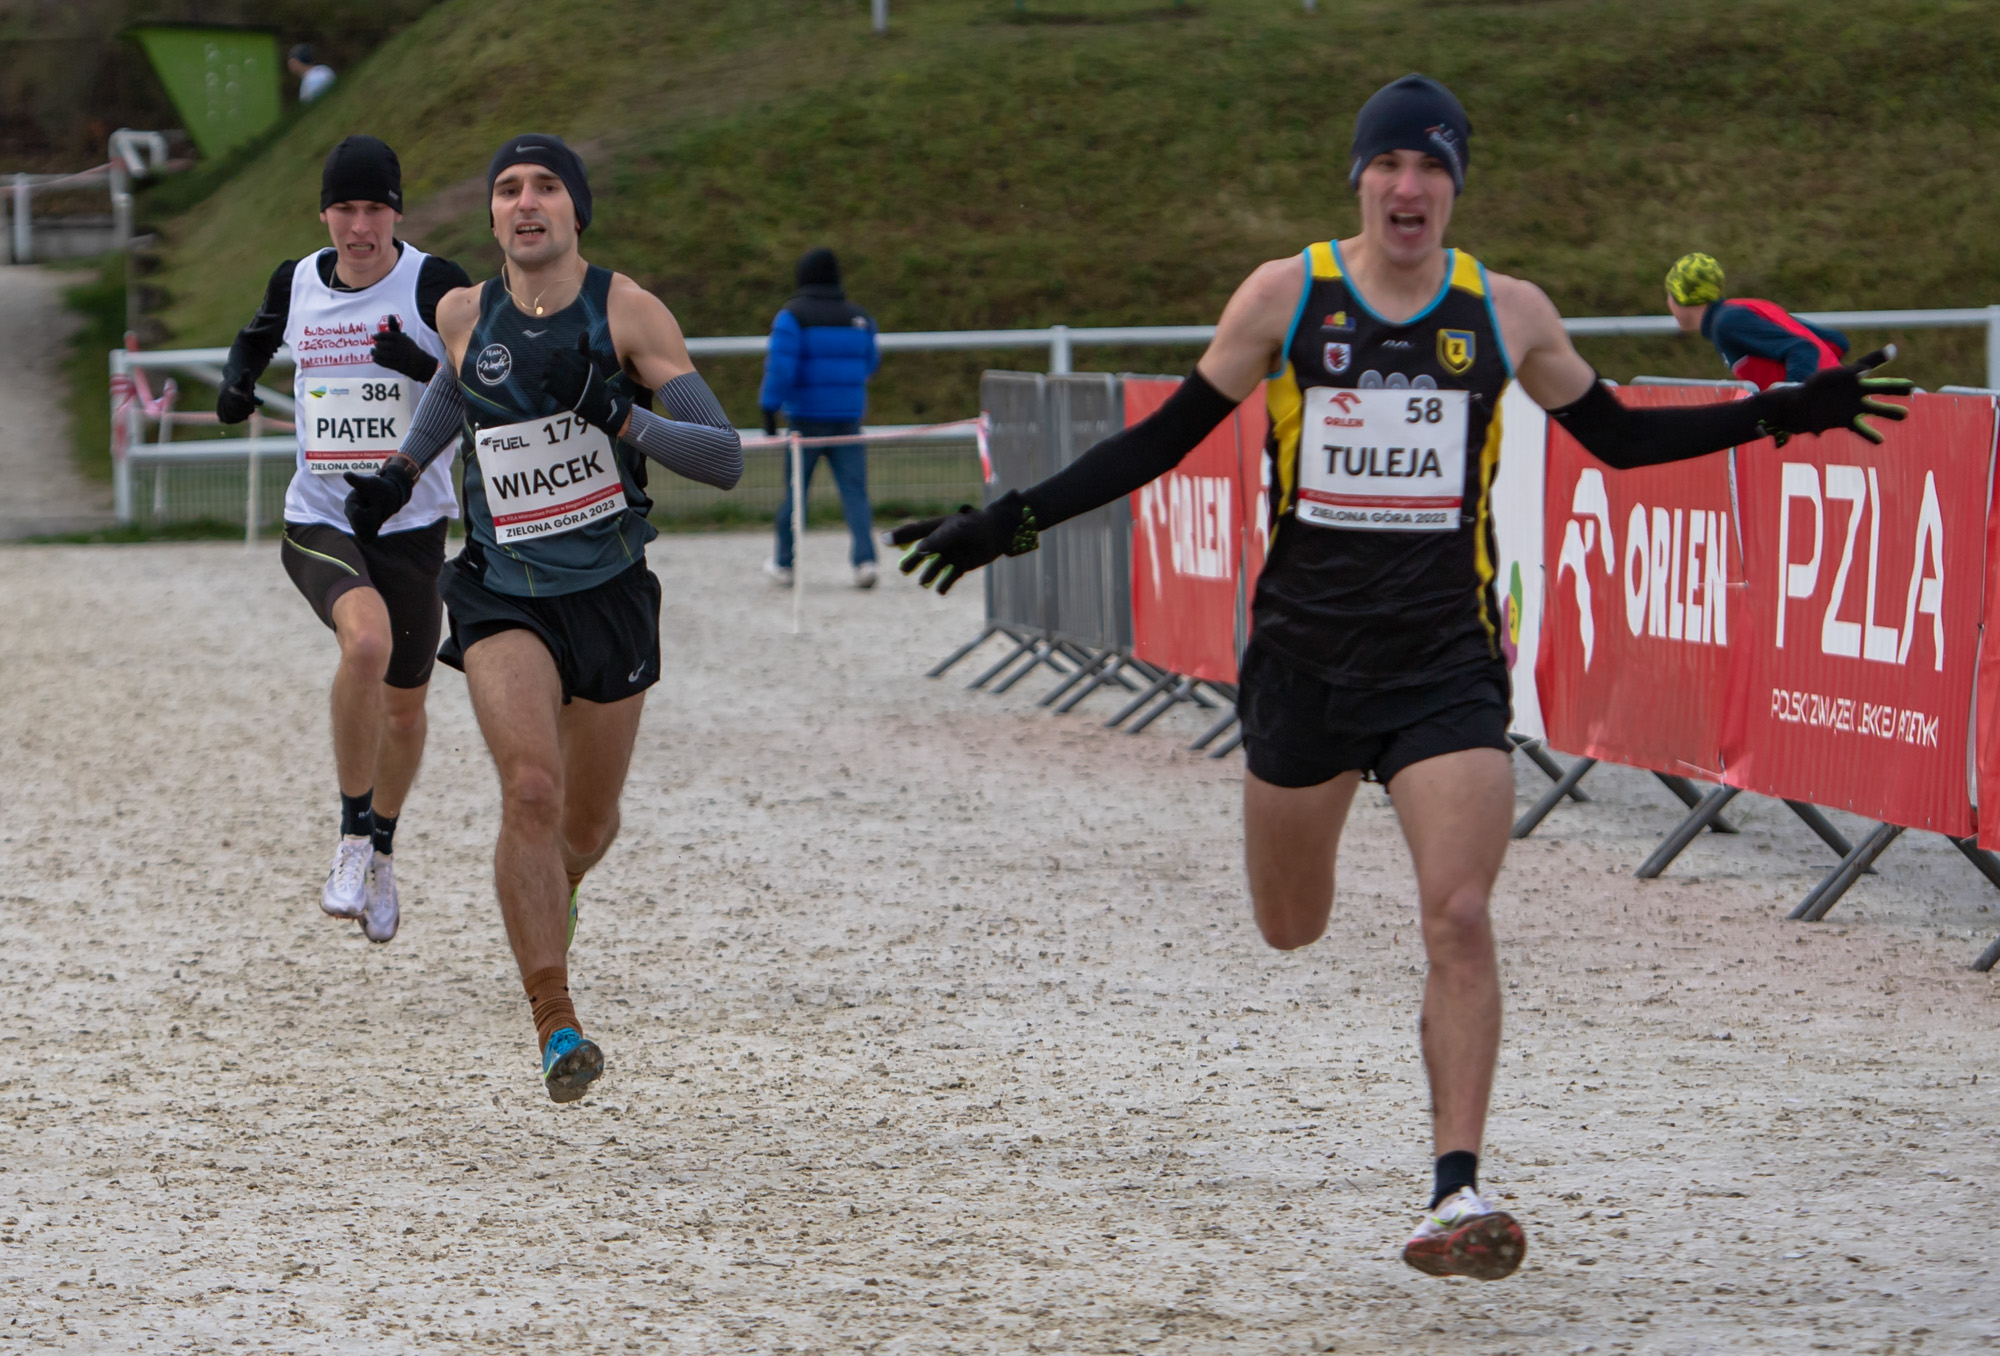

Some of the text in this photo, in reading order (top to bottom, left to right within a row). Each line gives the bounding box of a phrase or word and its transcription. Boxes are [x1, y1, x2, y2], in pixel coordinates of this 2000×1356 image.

[361, 383, 401, 401] 384
[1323, 416, 1364, 427] ORLEN
[1406, 397, 1443, 424] 58
[317, 417, 396, 442] PIĄTEK
[542, 416, 588, 445] 179
[492, 436, 530, 452] FUEL
[311, 461, 380, 470] ZIELONA GÓRA
[1323, 444, 1443, 477] TULEJA
[492, 450, 605, 500] WIĄCEK
[506, 499, 616, 538] ZIELONA GÓRA 2023
[1169, 471, 1231, 579] ORLEN
[1310, 506, 1447, 523] ZIELONA GÓRA 2023
[1624, 502, 1727, 647] ORLEN
[1776, 462, 1944, 672] PZLA
